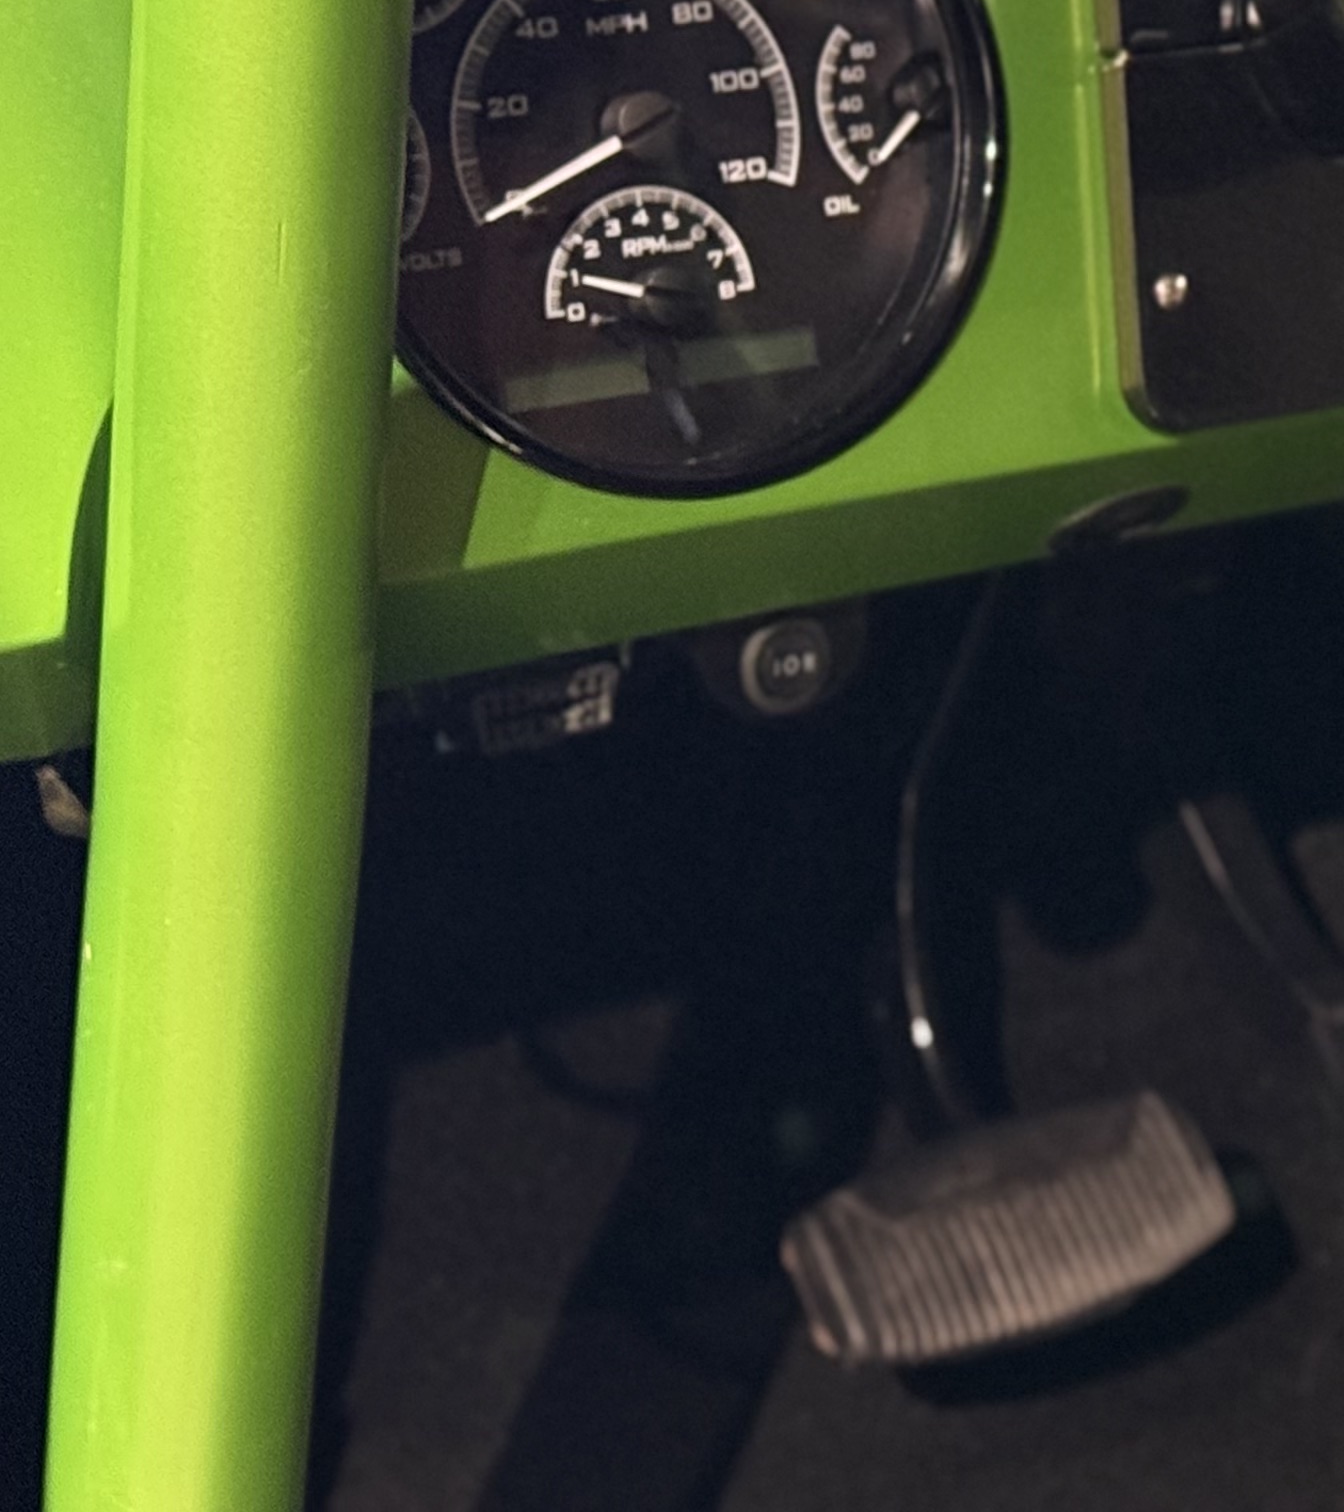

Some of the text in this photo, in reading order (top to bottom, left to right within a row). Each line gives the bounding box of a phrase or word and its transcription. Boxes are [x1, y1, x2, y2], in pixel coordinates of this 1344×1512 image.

[584, 9, 650, 37] MPH
[671, 0, 714, 25] 80
[515, 15, 559, 39] 40
[848, 39, 877, 61] 80
[708, 67, 760, 94] 100
[839, 64, 866, 85] 60
[486, 93, 529, 119] 20
[838, 93, 865, 114] 40
[847, 121, 875, 144] 20
[718, 155, 769, 184] 120
[822, 193, 862, 218] OIL
[603, 217, 622, 238] 3
[631, 208, 650, 227] 4
[661, 210, 681, 231] 5
[582, 238, 602, 261] 2
[620, 234, 668, 259] RPM
[706, 249, 724, 270] 7
[717, 278, 738, 300] 8
[566, 301, 587, 323] 0
